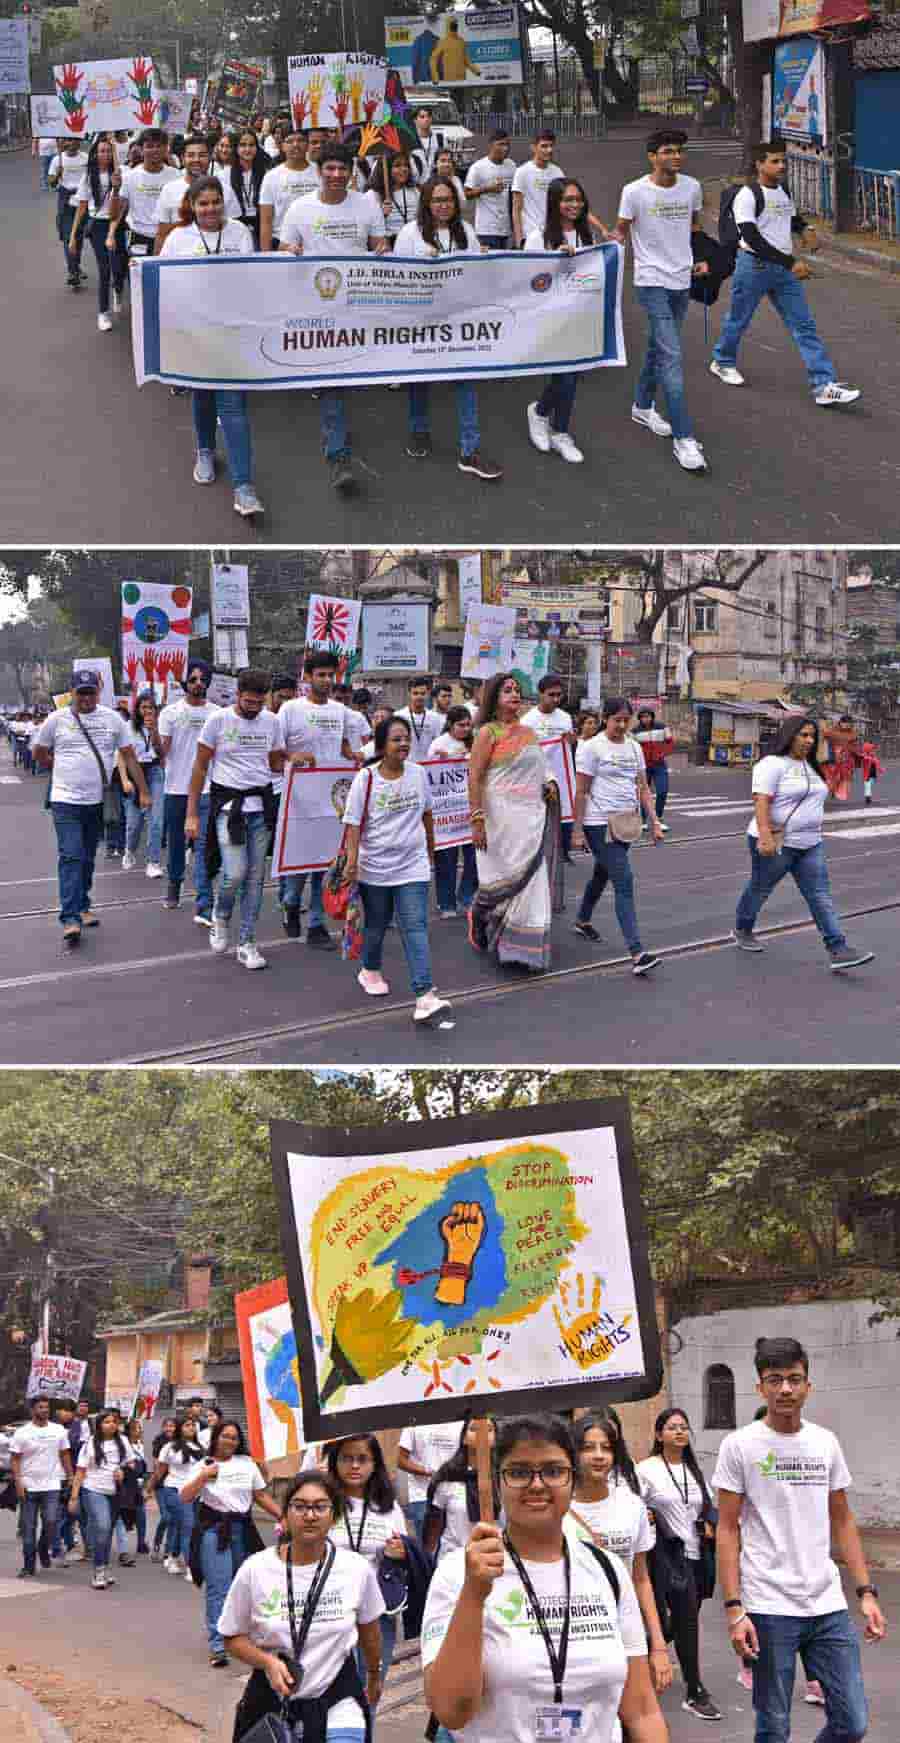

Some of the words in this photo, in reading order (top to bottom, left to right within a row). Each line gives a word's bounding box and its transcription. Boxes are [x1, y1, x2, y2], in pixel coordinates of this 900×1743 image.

[289, 56, 325, 68] HUMAN
[372, 267, 405, 280] BIRLA
[408, 267, 464, 281] INSTITUTE
[286, 318, 336, 329] WORLD
[283, 327, 365, 351] HUMAN
[374, 324, 453, 345] RIGHTS
[461, 321, 503, 341] DAY
[512, 1162, 552, 1177] STOP
[517, 1209, 553, 1229] LOVE
[344, 1222, 374, 1250] FREE
[516, 1226, 567, 1251] PEACE
[557, 1311, 614, 1359] HUMAN
[579, 1326, 631, 1368] RIGHTS
[571, 1604, 609, 1618] RIGHTS
